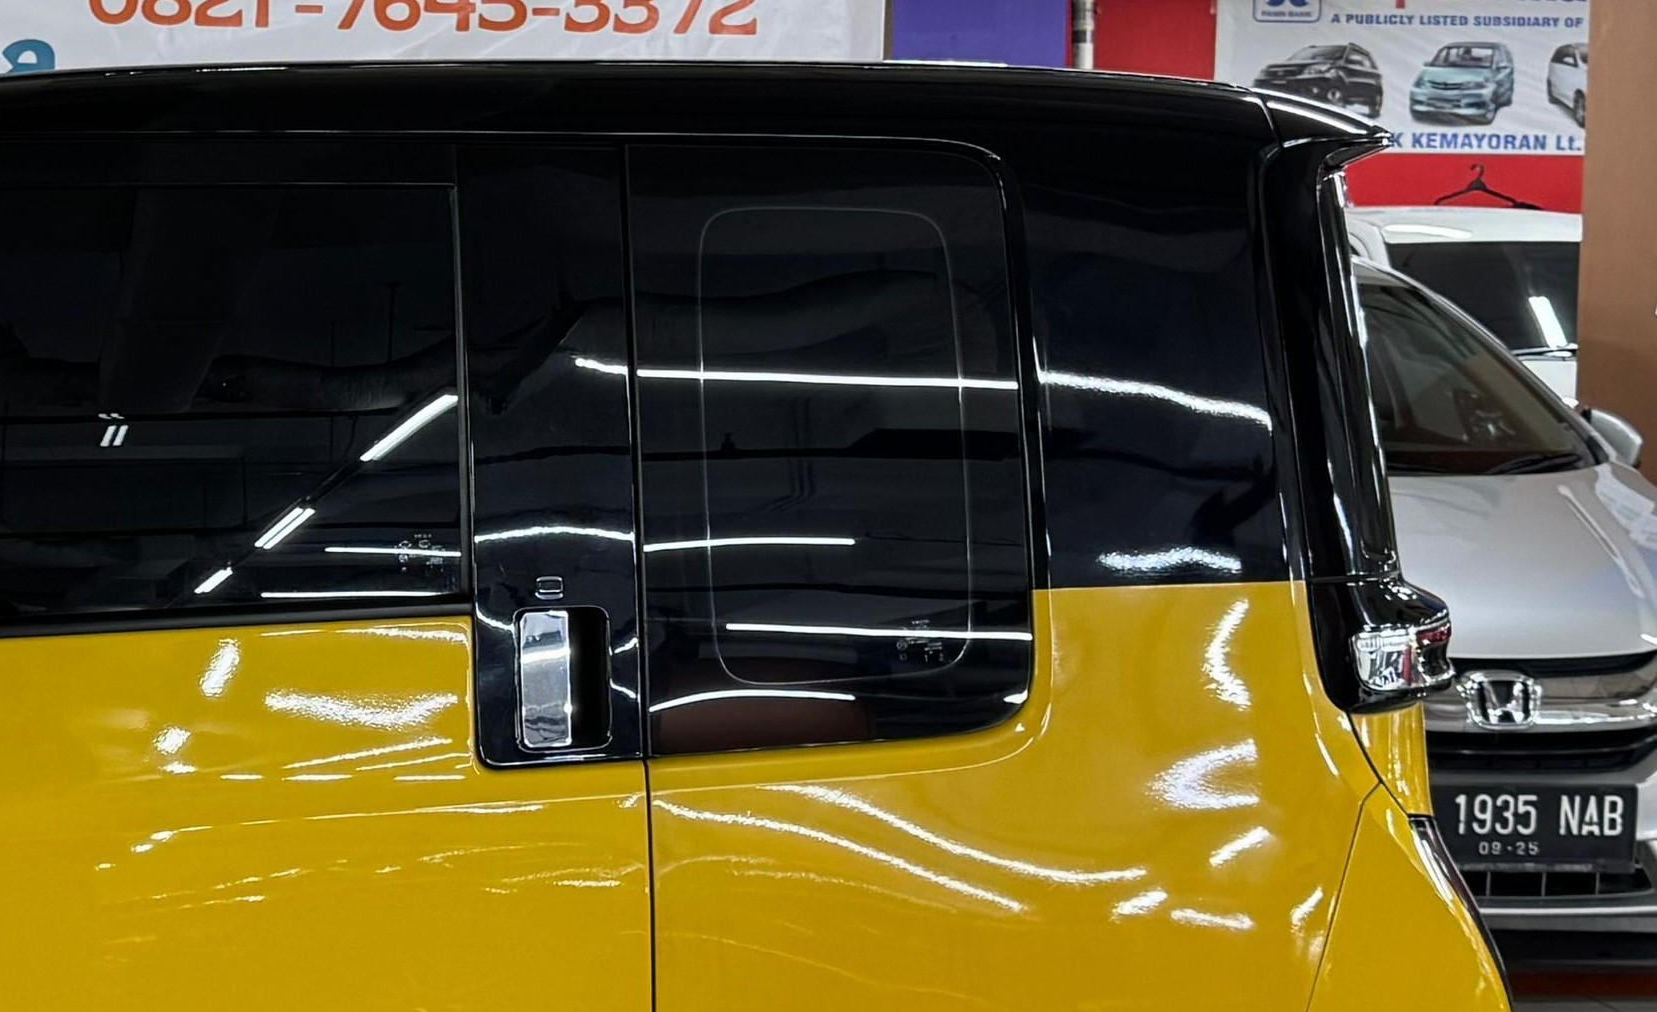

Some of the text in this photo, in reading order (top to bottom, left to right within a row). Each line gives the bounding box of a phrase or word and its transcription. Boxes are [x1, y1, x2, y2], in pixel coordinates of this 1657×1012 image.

[1331, 14, 1584, 28] A PUBLICLY LISTED SUBSIDIARY OF
[1411, 133, 1547, 150] KEMAYORAN
[1555, 134, 1582, 151] Lt.
[1455, 794, 1624, 837] 1935 NAB
